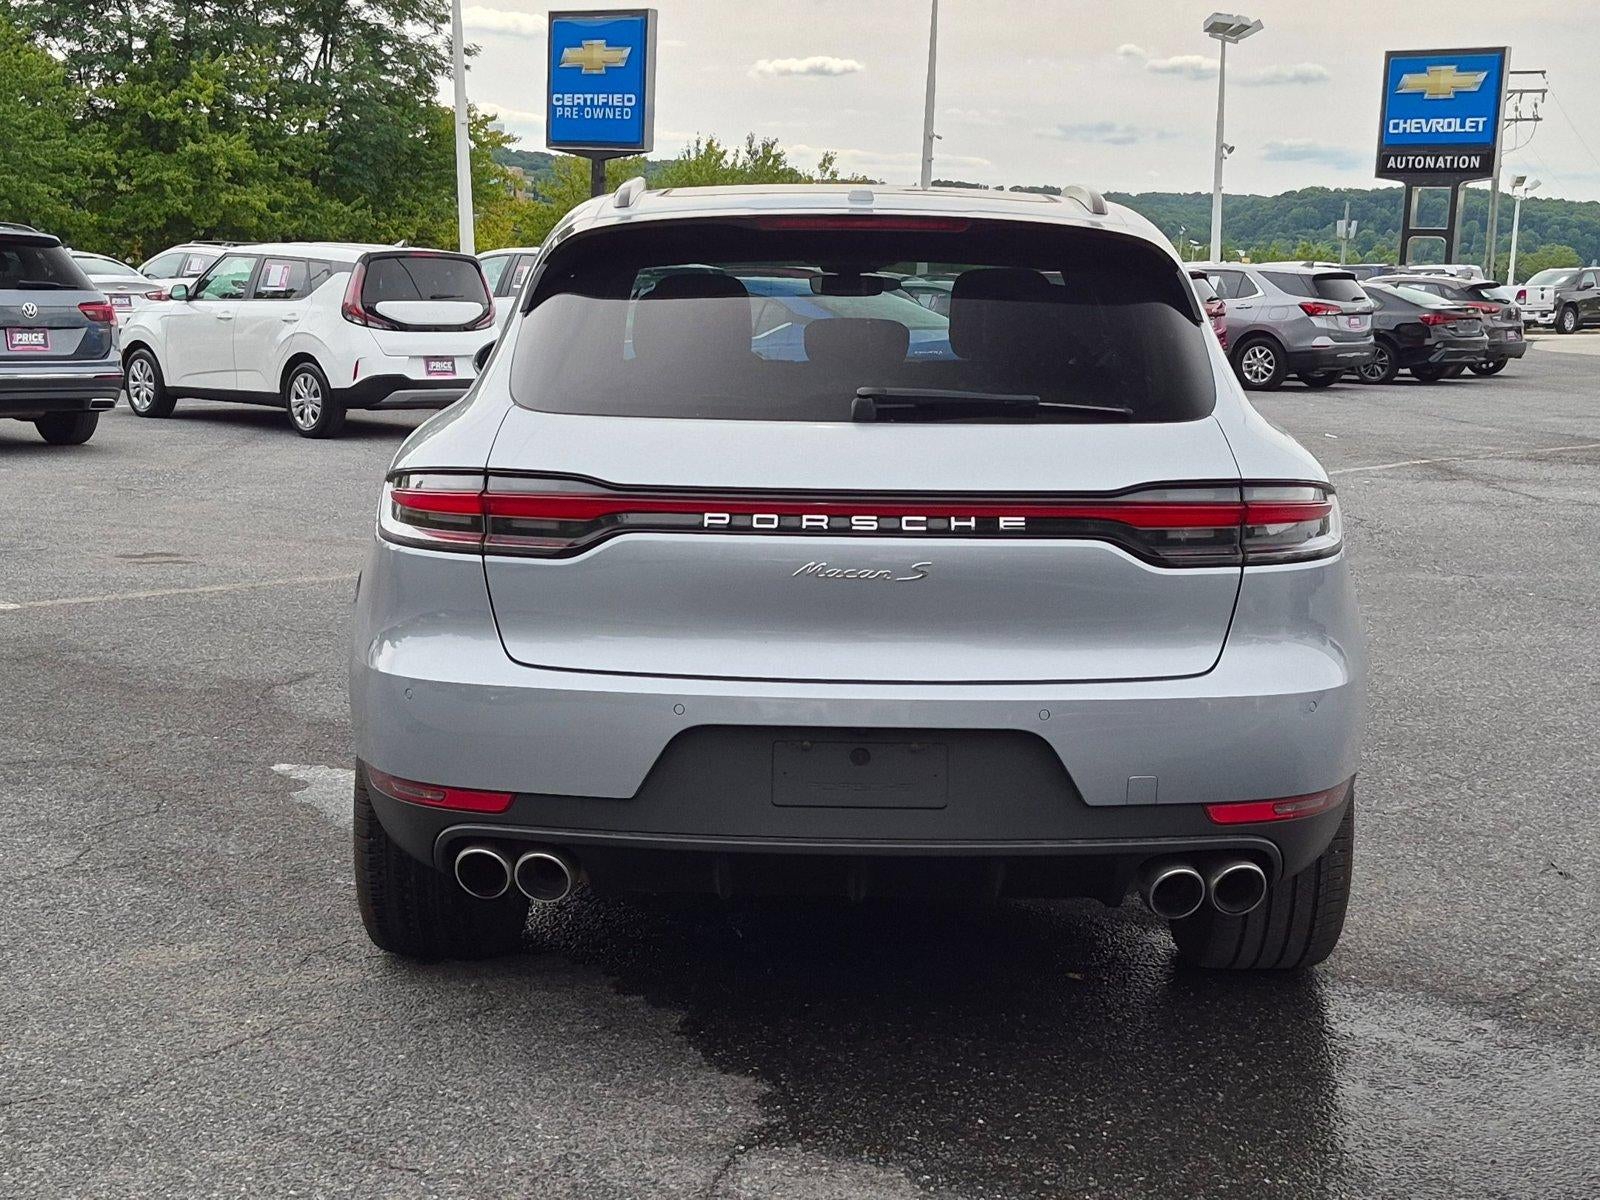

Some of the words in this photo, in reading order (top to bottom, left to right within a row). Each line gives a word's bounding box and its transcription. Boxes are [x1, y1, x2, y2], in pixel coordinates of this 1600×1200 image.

[552, 93, 636, 107] CERTIFIED
[556, 107, 632, 120] PRE-OWNED
[1388, 117, 1488, 134] CHEVROLET
[1387, 155, 1480, 169] AUTONATION
[703, 512, 1027, 531] PORSCHE
[792, 561, 892, 580] Macan
[896, 561, 933, 582] S
